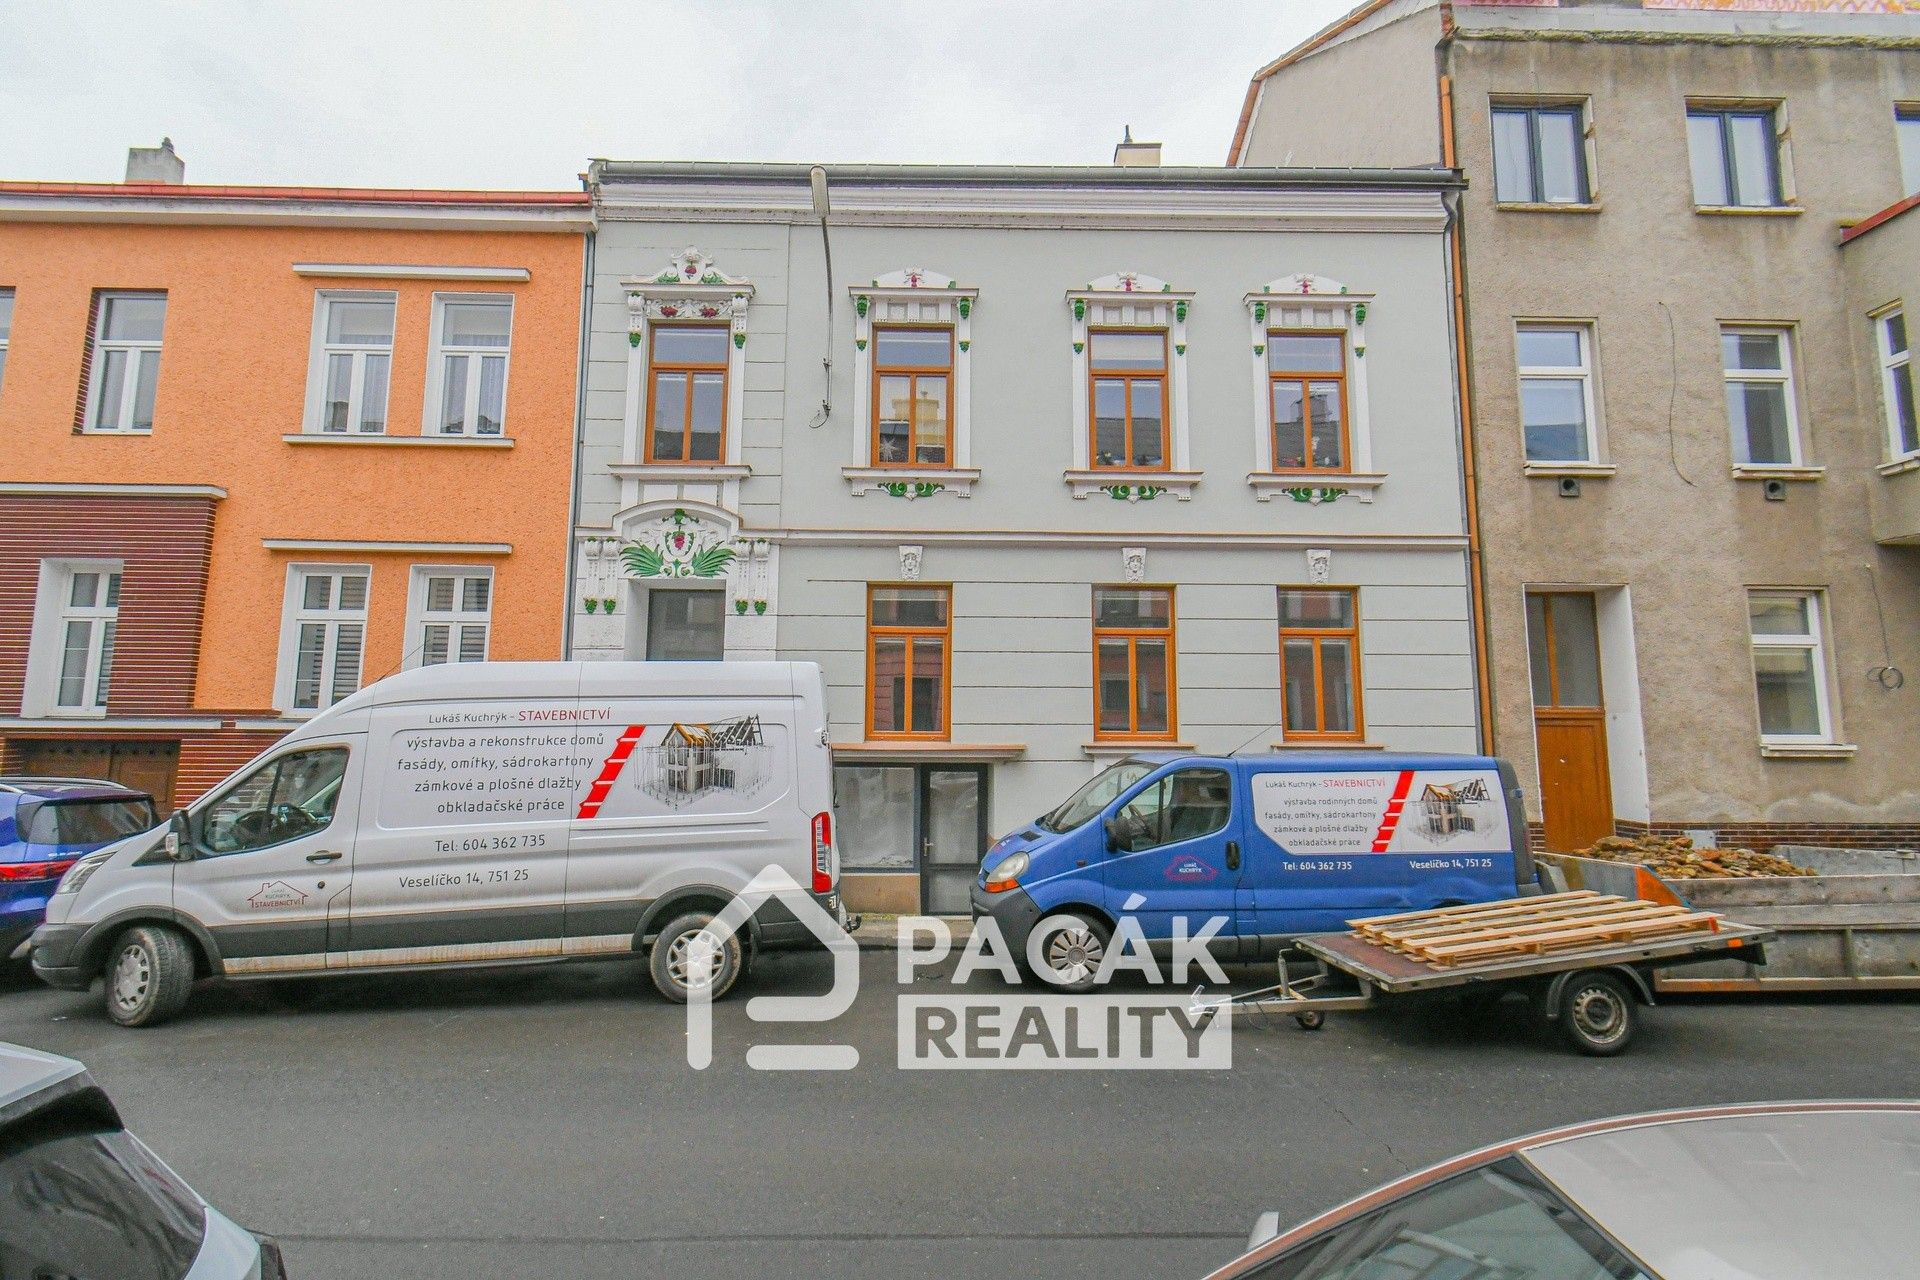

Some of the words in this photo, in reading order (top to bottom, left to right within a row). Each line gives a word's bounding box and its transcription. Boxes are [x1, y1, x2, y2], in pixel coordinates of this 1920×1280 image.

[429, 713, 461, 724] Lukáš
[464, 712, 508, 724] Kuchrýk
[518, 707, 611, 721] STAVEBNICTVÍ
[407, 735, 465, 751] výstavba
[469, 738, 476, 747] a
[480, 734, 567, 747] rekonstrukce
[570, 733, 604, 746] domů
[398, 758, 448, 773] fasády,
[451, 757, 498, 771] omítky,
[502, 756, 594, 769] sádrokartony
[414, 779, 473, 792] zámkové
[477, 782, 484, 791] a
[489, 778, 534, 793] plošné
[538, 776, 581, 791] dlažby
[1323, 777, 1386, 788] STAVEBNICTVÍ
[437, 799, 523, 813] obkladačské
[527, 799, 565, 813] práce
[1284, 798, 1316, 807] výstavba
[1319, 797, 1356, 807] rodinných
[1358, 796, 1378, 805] domů
[1343, 824, 1368, 834] dlažby
[435, 840, 459, 852] Tel:
[463, 838, 488, 851] 604
[492, 836, 516, 850] 362
[522, 834, 546, 847] 735
[1283, 861, 1298, 870] Tel:
[1300, 861, 1316, 870] 604
[1318, 861, 1334, 870] 362
[1336, 861, 1352, 870] 735
[1409, 859, 1450, 869] Veselíčko
[1465, 858, 1479, 868] 751
[1481, 858, 1492, 867] 25
[399, 873, 461, 888] Veselíčko
[466, 872, 483, 885] 14,
[488, 870, 508, 883] 751
[514, 868, 529, 881] 25
[255, 898, 300, 908] STAVEBNICTVÍ
